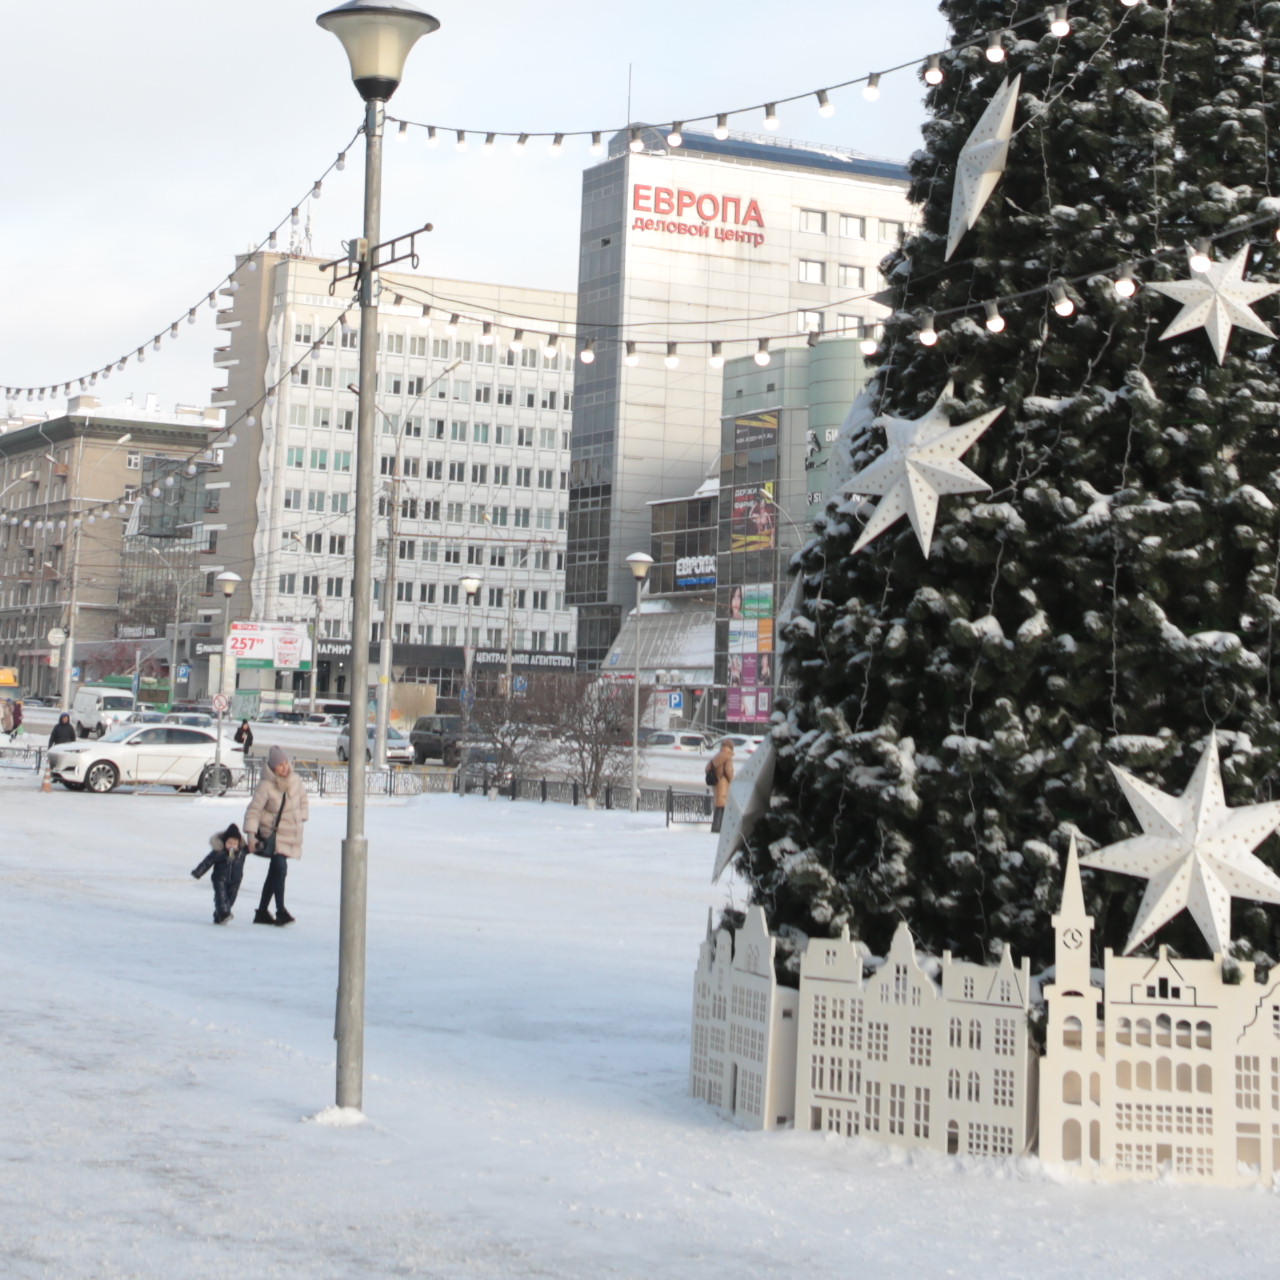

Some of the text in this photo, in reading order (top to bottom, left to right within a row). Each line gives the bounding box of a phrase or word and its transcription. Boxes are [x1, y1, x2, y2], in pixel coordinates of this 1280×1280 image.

[633, 184, 765, 228] ЕВРОПА
[632, 217, 765, 248] деловой центр
[676, 555, 716, 576] ЕВРОПА
[530, 655, 571, 667] АГЕНТСТВО
